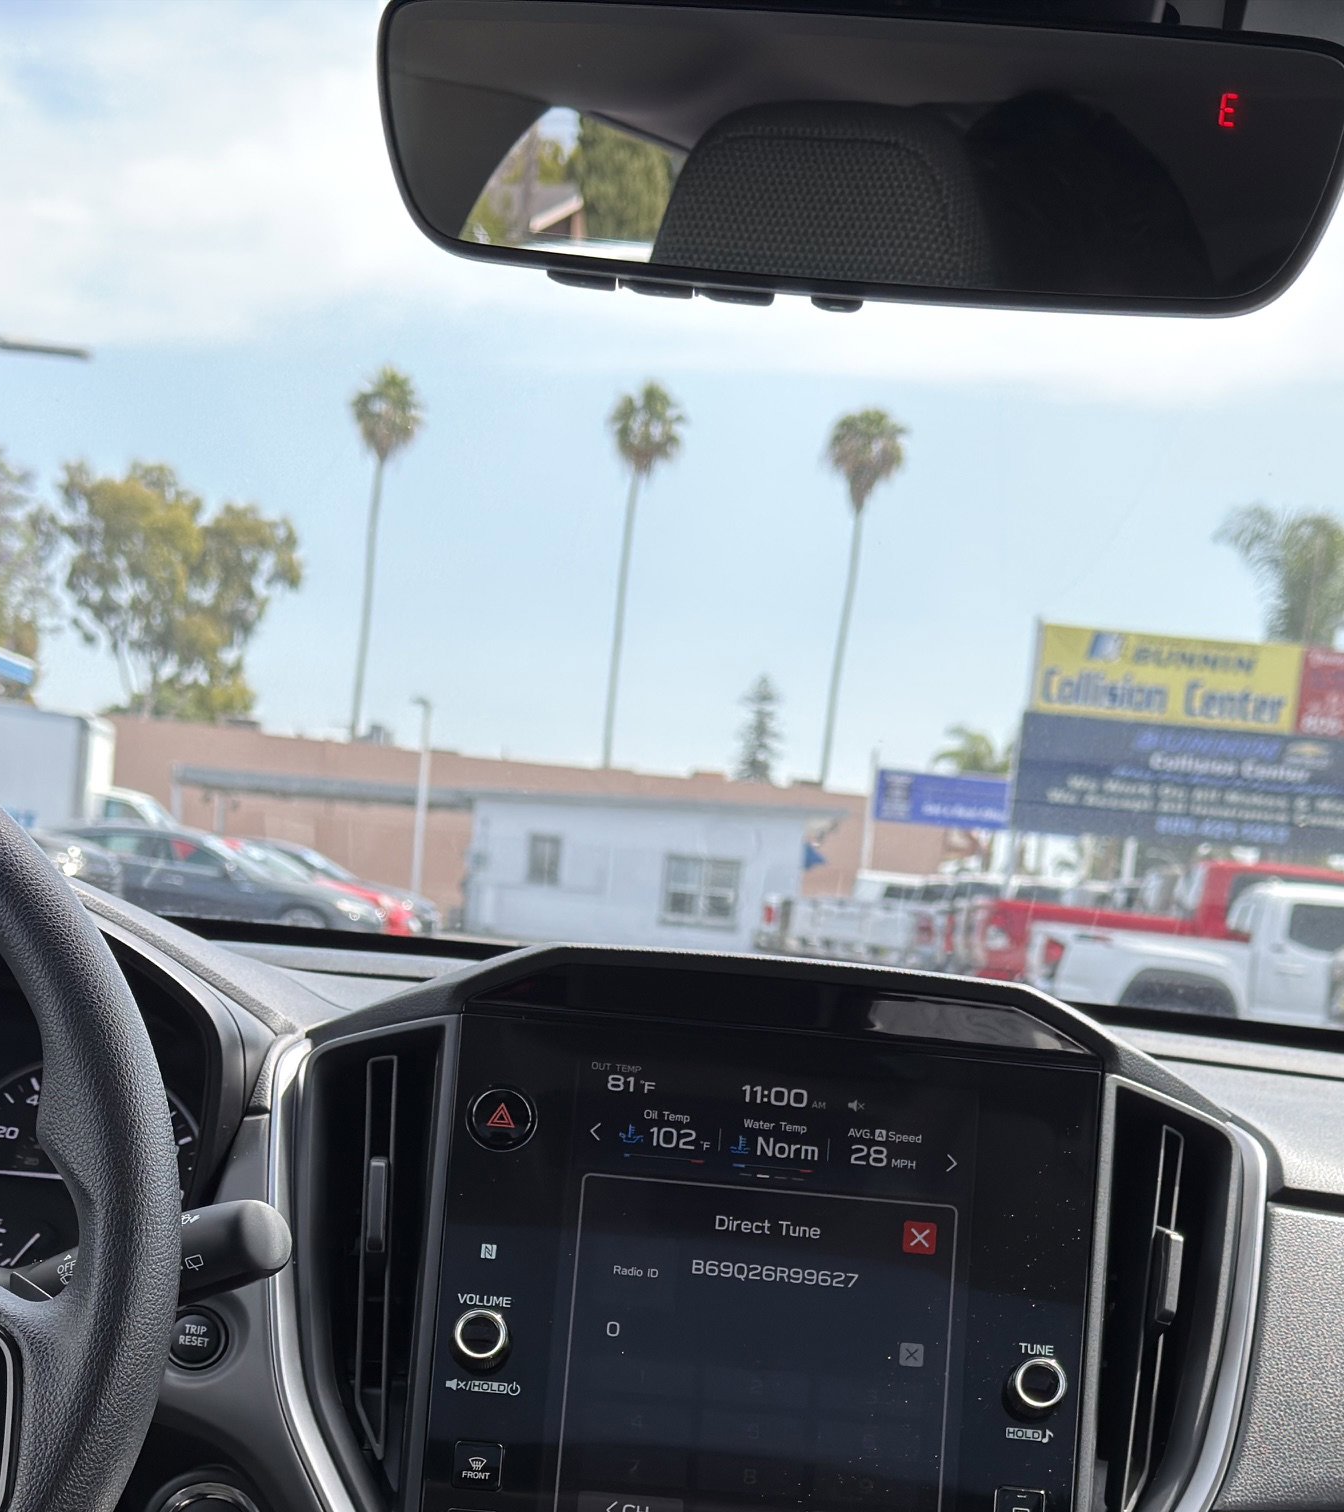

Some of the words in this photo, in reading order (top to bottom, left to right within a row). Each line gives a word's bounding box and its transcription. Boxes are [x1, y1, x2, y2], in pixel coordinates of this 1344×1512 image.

[1217, 93, 1240, 128] E
[1042, 668, 1169, 714] Collision
[1184, 679, 1287, 725] Center
[591, 1061, 616, 1073] OUT
[618, 1062, 642, 1075] TEMP
[606, 1074, 637, 1093] 81
[741, 1083, 810, 1108] 11:00
[643, 1109, 659, 1122] Oil
[662, 1111, 691, 1127] Temp
[743, 1118, 771, 1132] Water
[774, 1121, 808, 1135] Temp
[649, 1127, 697, 1151] 102
[888, 1131, 923, 1146] Speed
[756, 1136, 819, 1162] Norm
[849, 1144, 888, 1168] 28
[890, 1157, 917, 1170] MPH
[714, 1215, 773, 1237] Direct
[778, 1220, 821, 1242] Tune
[57, 1260, 77, 1274] OFF
[613, 1264, 644, 1278] Radio
[646, 1267, 659, 1278] ID
[457, 1293, 512, 1309] VOLUME
[185, 1324, 207, 1336] TRIP
[178, 1335, 210, 1347] RESET
[1019, 1342, 1054, 1356] TUNE
[472, 1382, 507, 1394] HOLD
[1006, 1428, 1042, 1441] HOLD
[461, 1470, 490, 1481] FRONT
